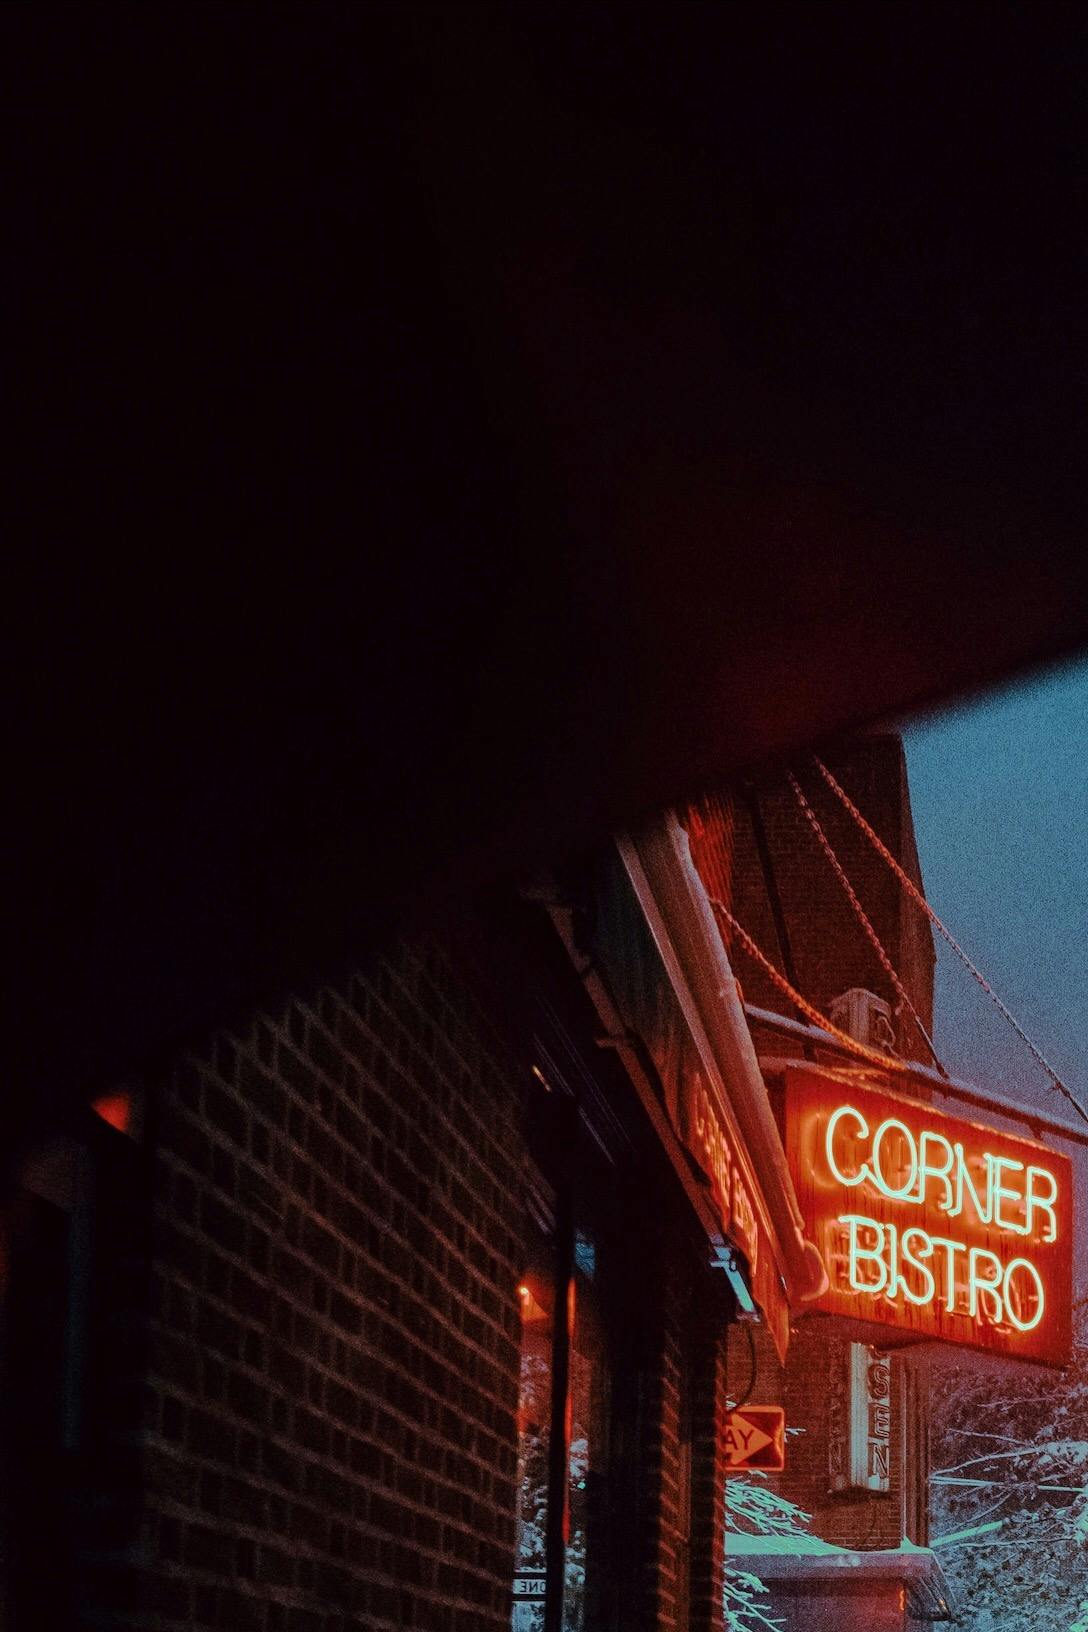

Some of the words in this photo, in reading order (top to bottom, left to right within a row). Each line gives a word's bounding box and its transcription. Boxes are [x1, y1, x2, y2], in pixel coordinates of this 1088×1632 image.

[824, 1104, 1059, 1244] CORNER
[840, 1214, 1046, 1332] BISTRO
[724, 1429, 755, 1451] AY
